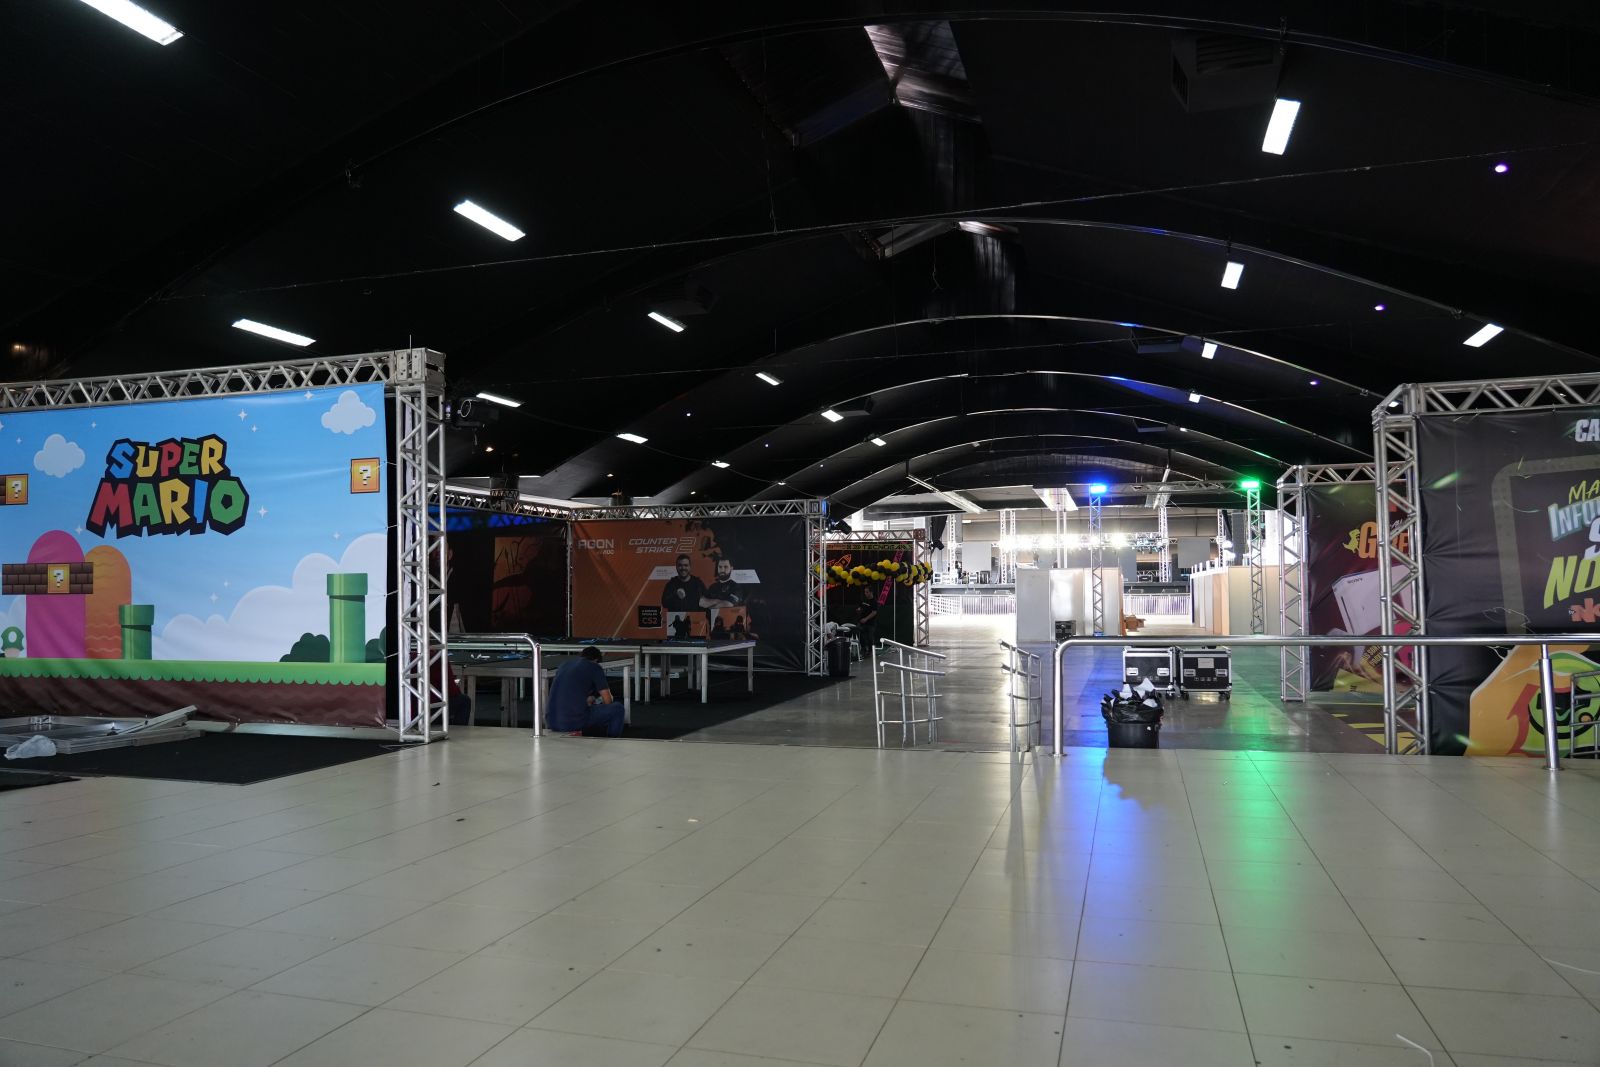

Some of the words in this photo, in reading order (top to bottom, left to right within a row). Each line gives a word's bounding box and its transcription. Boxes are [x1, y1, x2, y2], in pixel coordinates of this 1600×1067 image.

[106, 435, 228, 479] SUPER
[87, 477, 248, 536] MARIO
[577, 538, 614, 550] AGON
[628, 537, 677, 546] COUNTER
[635, 545, 673, 554] STRIKE
[675, 536, 697, 554] 2
